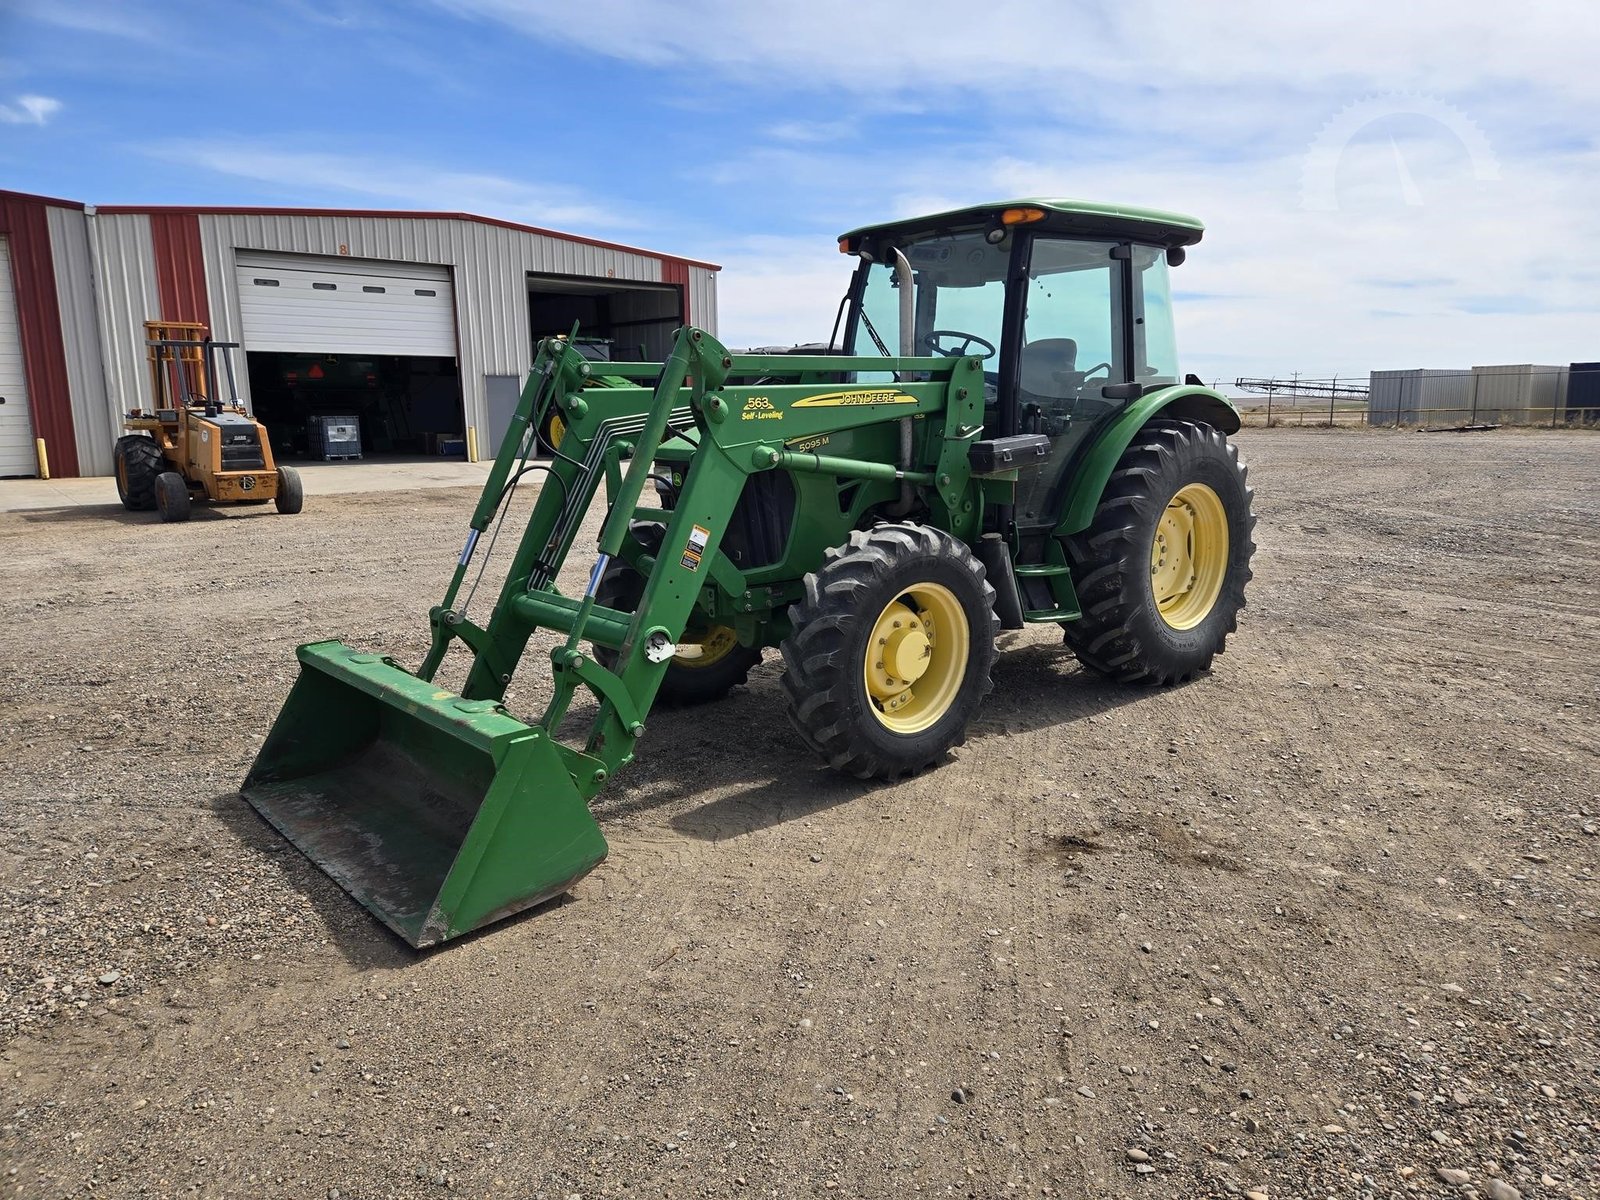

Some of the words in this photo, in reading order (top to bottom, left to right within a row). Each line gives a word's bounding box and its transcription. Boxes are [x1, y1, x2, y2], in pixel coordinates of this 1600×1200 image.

[340, 244, 348, 256] 8
[747, 397, 769, 408] 563
[839, 394, 865, 404] JOHN
[864, 392, 895, 403] DEERE
[799, 439, 821, 453] 5095
[822, 436, 830, 445] M
